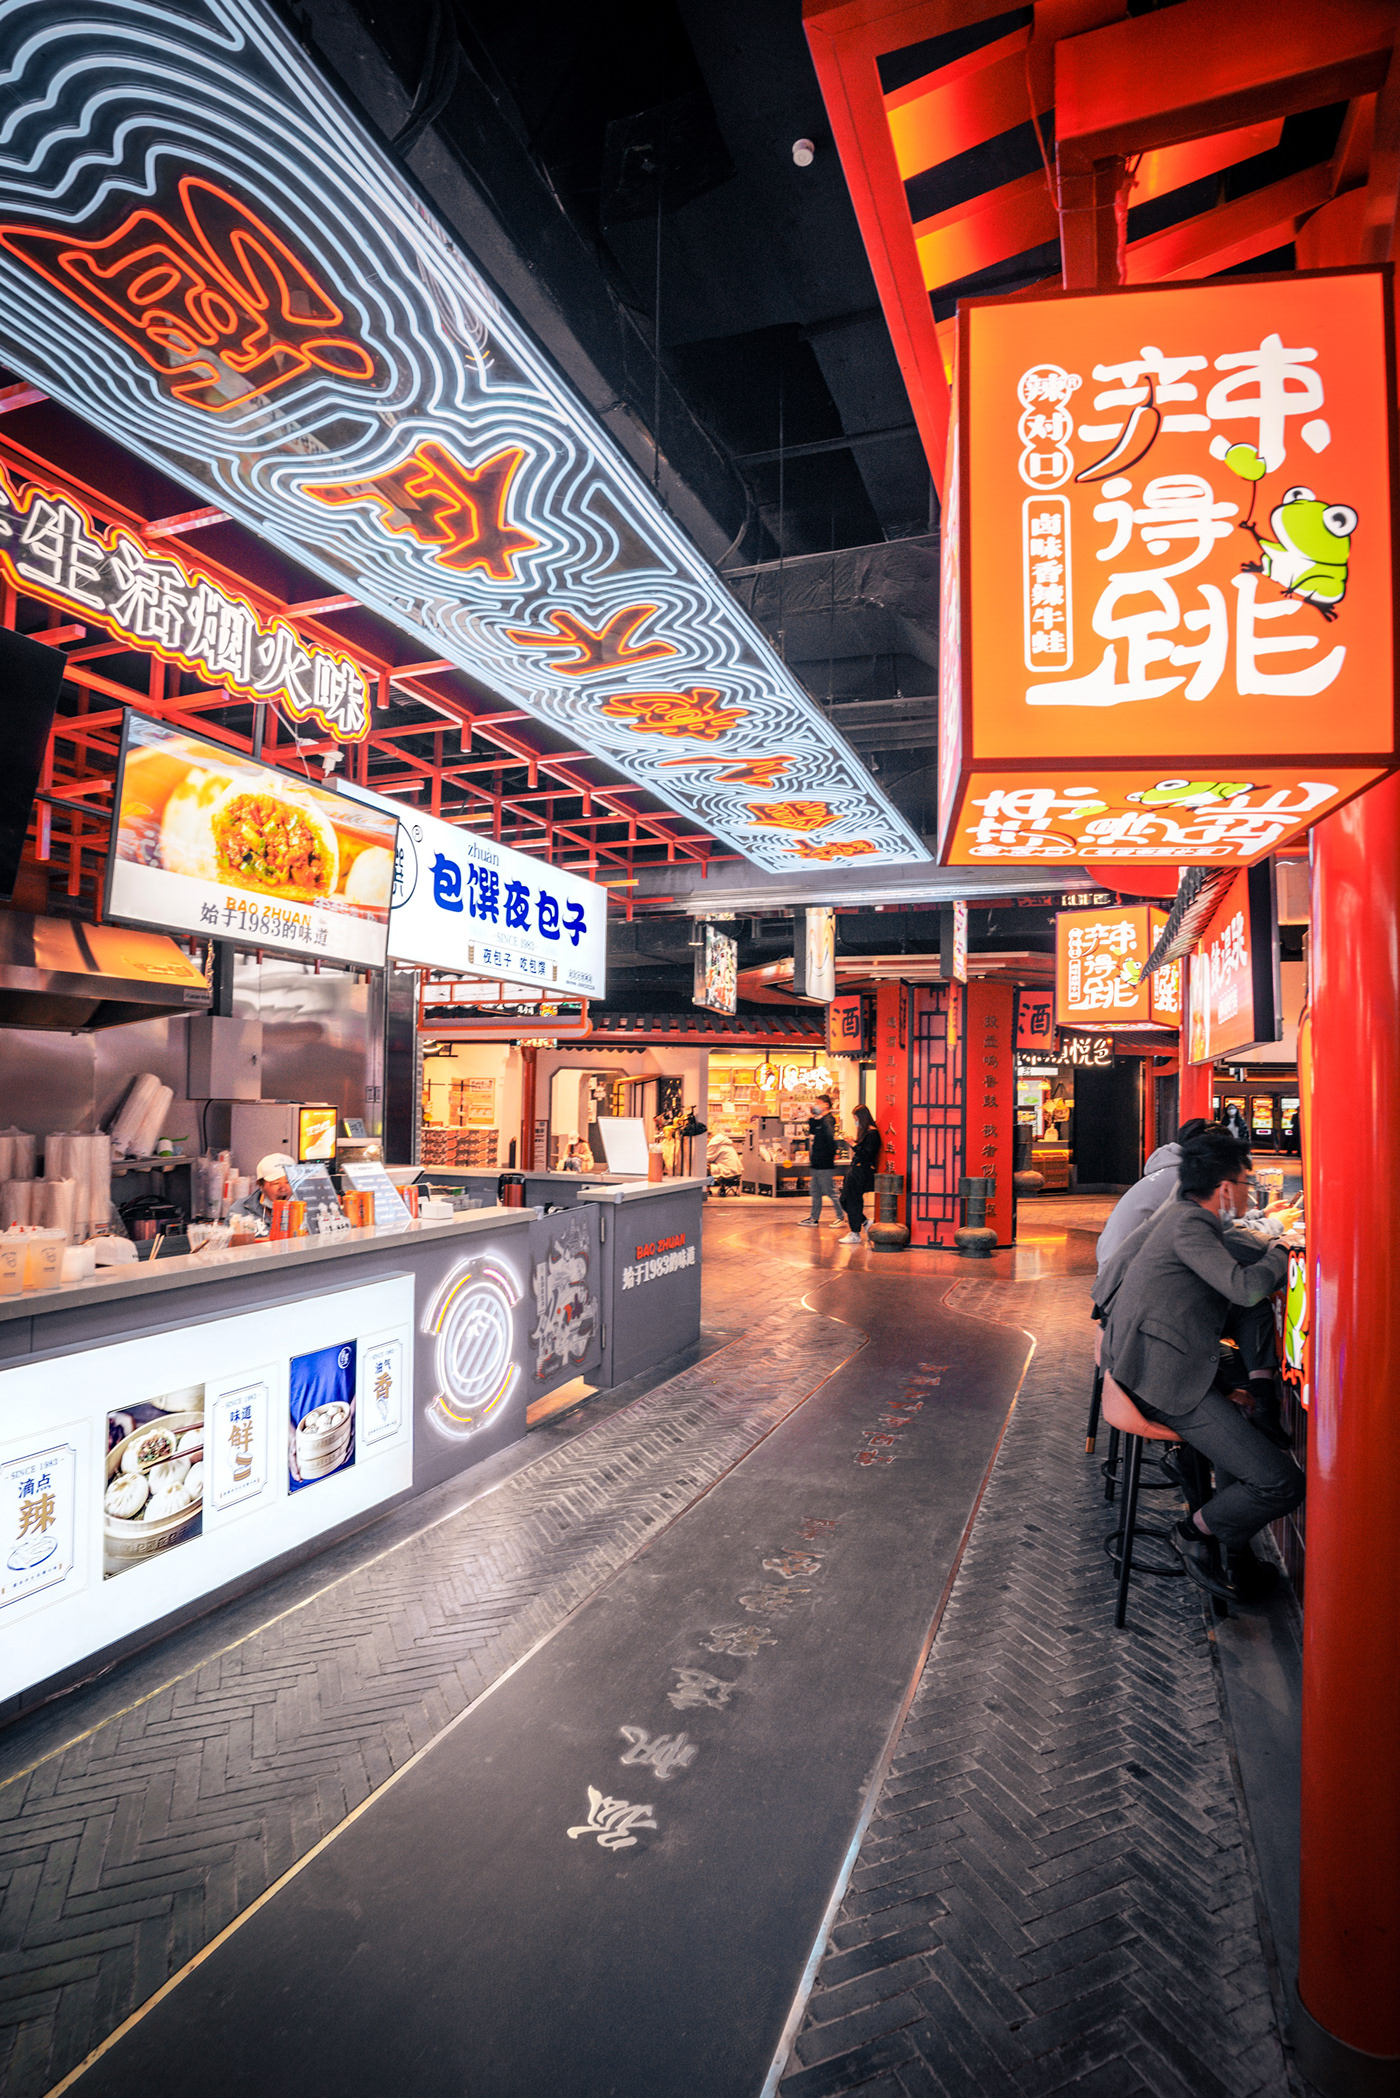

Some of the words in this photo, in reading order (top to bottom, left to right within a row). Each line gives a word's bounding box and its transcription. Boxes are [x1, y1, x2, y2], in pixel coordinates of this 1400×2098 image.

[1024, 373, 1066, 477] 辣对口
[1026, 333, 1348, 707] 辣得跳
[1031, 513, 1067, 655] 卤味香辣牛蛙
[0, 492, 365, 731] 生活烟火味
[226, 896, 259, 915] BAO
[263, 905, 313, 927] ZHUAN
[428, 849, 588, 947] 包馔夜包子
[200, 902, 329, 947] 始于1983的味道
[1068, 920, 1140, 1010] 辣得跳
[831, 1006, 861, 1038] 酒
[1018, 1003, 1051, 1037] 酒
[636, 1242, 656, 1260] BAO
[657, 1233, 686, 1253] ZHUAN
[373, 1372, 393, 1400] 香
[230, 1405, 252, 1423] 味道
[228, 1420, 254, 1452] 鲜
[11, 1466, 36, 1480] SINCE
[18, 1474, 51, 1499] 滴点
[16, 1493, 57, 1541] 辣
